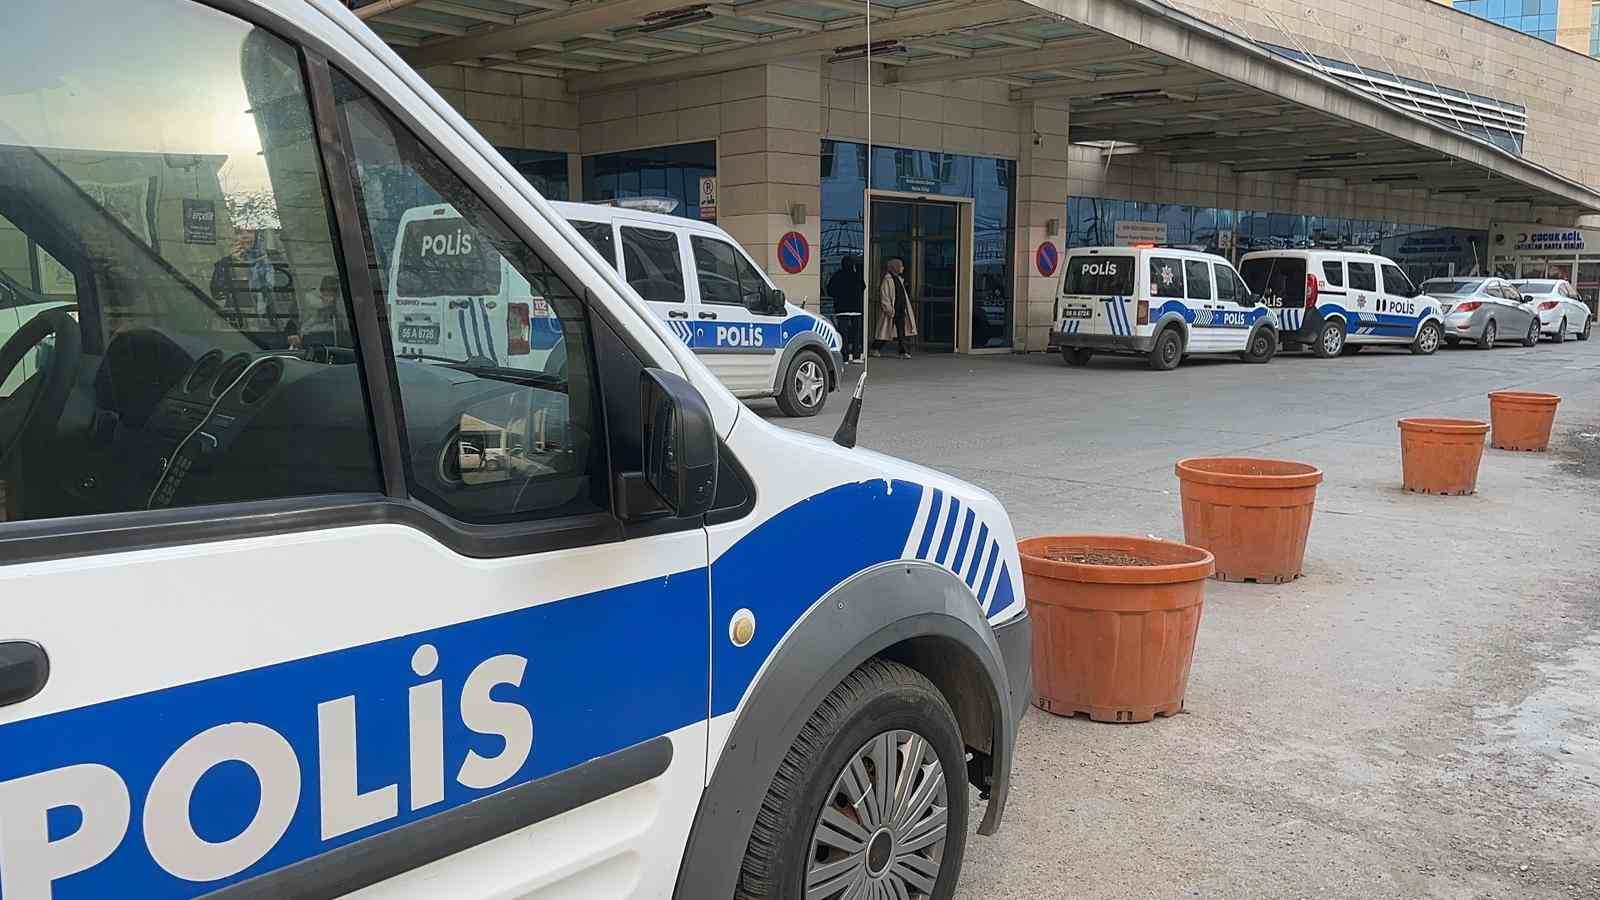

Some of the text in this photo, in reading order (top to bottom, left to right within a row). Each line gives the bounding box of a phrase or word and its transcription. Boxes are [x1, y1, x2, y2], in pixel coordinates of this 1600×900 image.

[421, 228, 472, 257] POLİS
[1081, 261, 1117, 276] POLİS
[1260, 295, 1283, 307] OLİS
[1389, 300, 1415, 315] POLİS
[1223, 311, 1245, 325] POLİS
[716, 323, 763, 347] POLİS
[0, 643, 534, 900] POLİS
